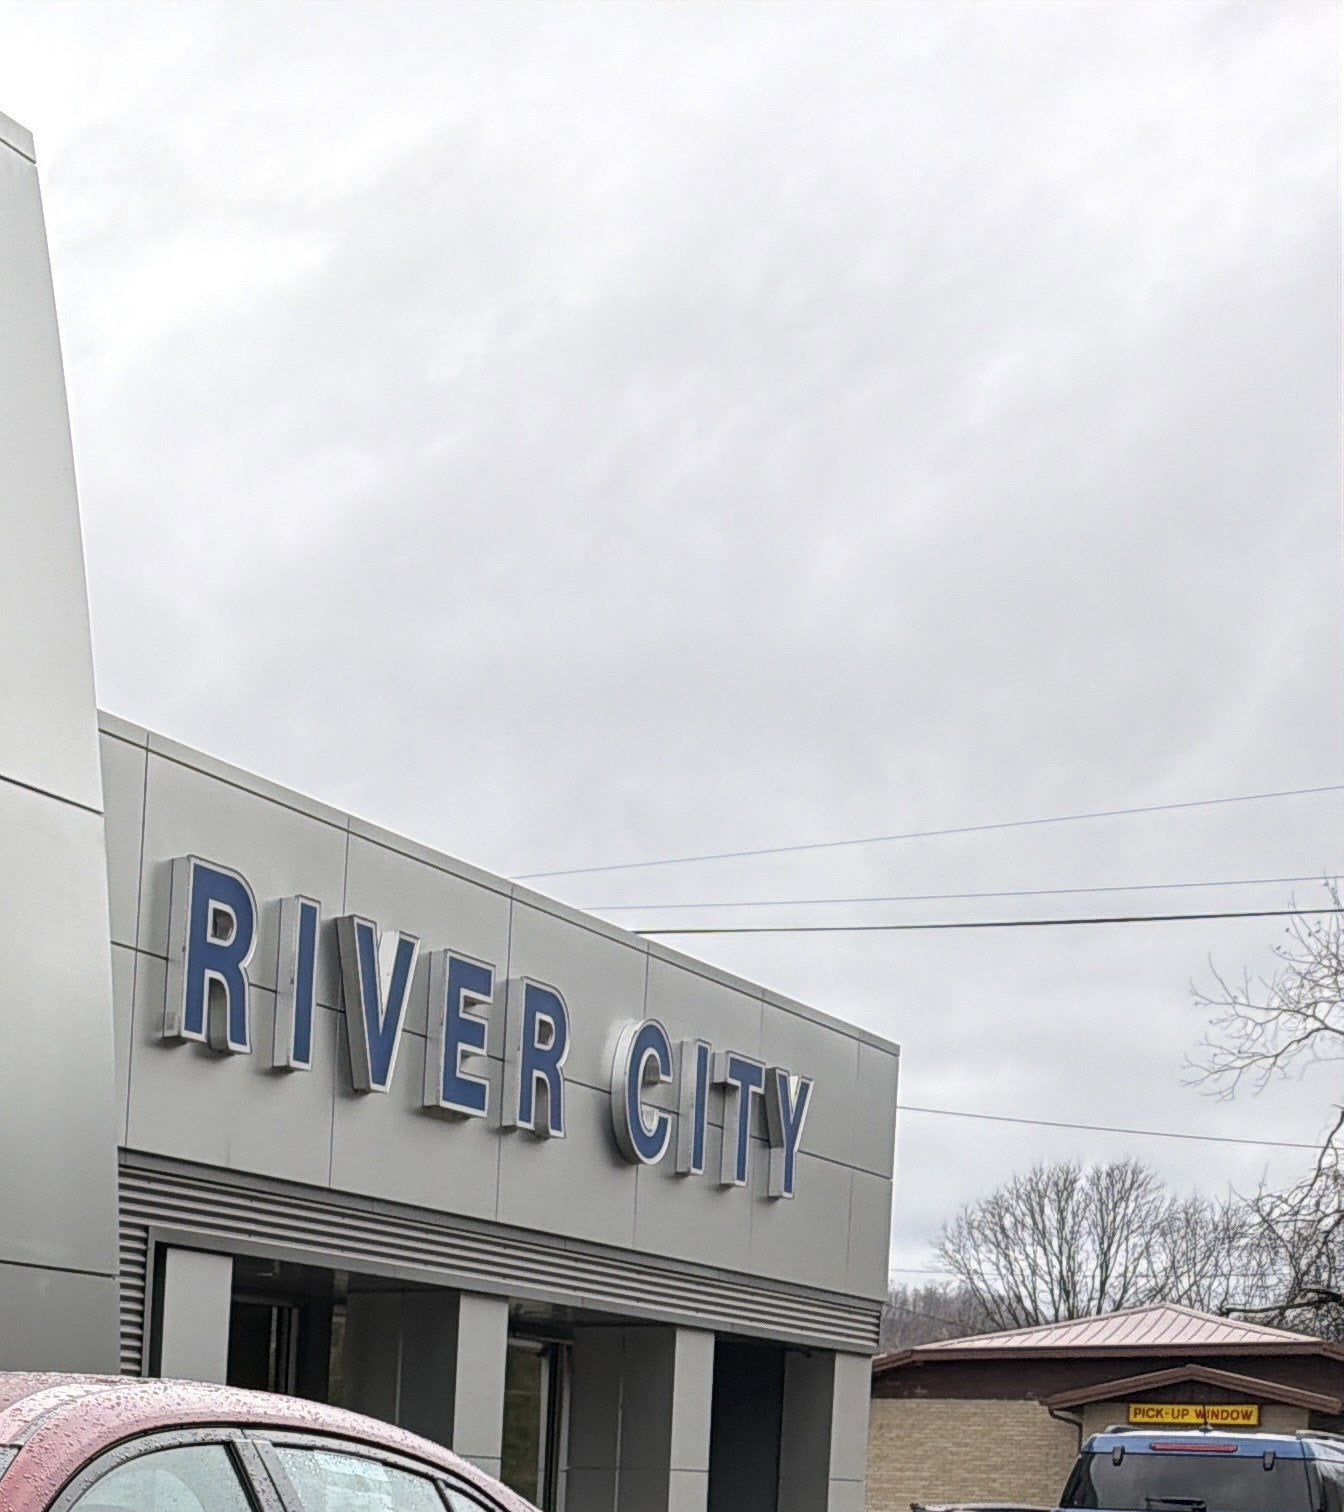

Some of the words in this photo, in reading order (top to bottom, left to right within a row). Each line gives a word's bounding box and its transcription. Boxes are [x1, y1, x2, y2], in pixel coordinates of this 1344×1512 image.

[180, 854, 570, 1138] RIVER
[616, 1018, 814, 1200] CITY
[1133, 1407, 1190, 1420] PICK-UP
[1195, 1408, 1254, 1421] WINDOW
